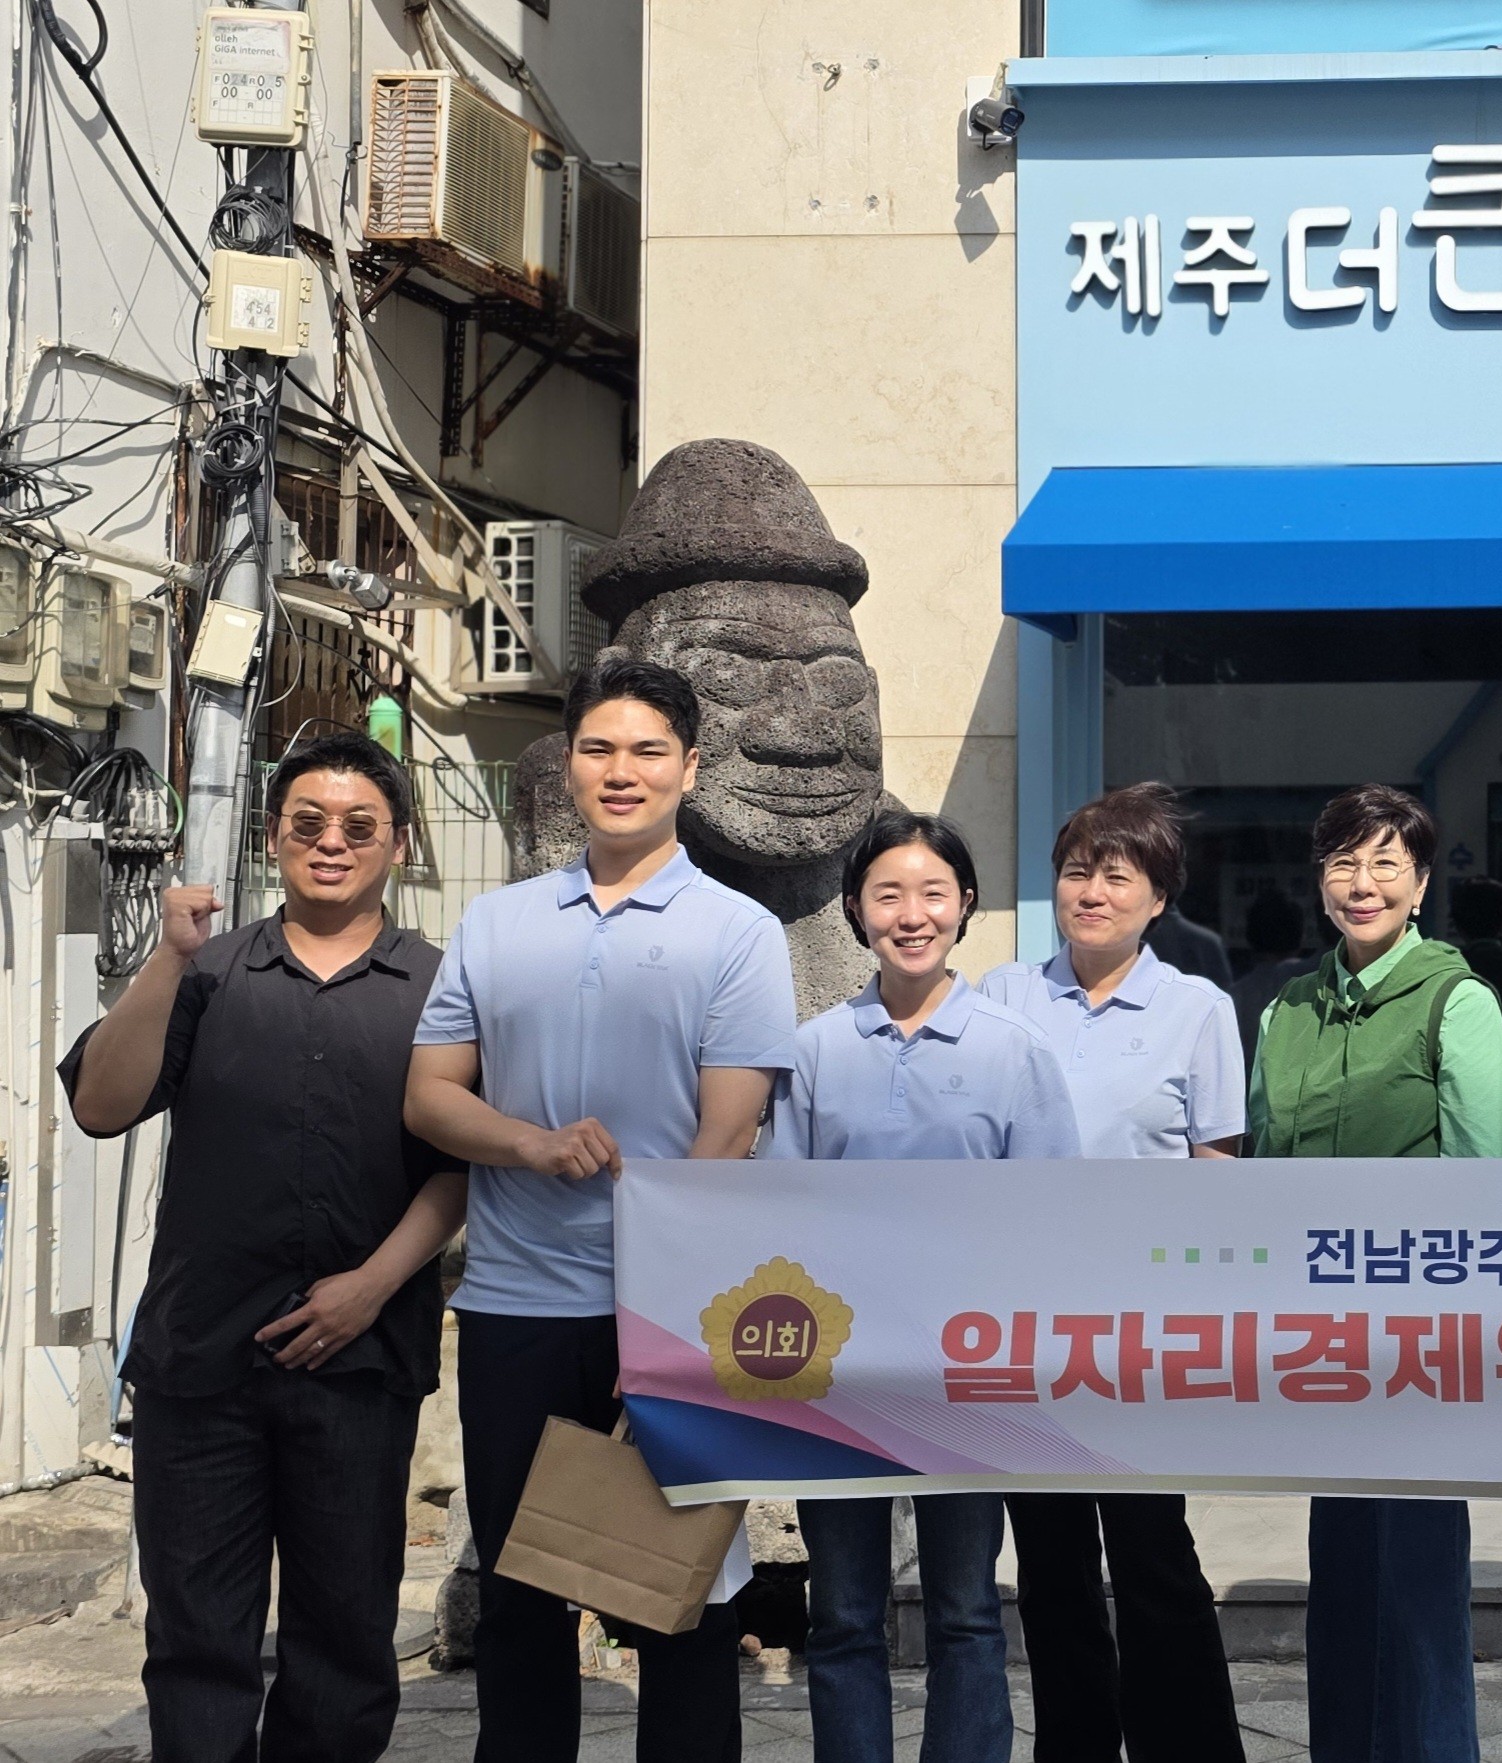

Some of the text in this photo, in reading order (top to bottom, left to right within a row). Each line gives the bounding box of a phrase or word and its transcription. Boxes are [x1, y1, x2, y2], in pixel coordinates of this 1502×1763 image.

[214, 34, 238, 43] olleh
[239, 46, 275, 56] internet
[736, 1320, 810, 1359] 의회
